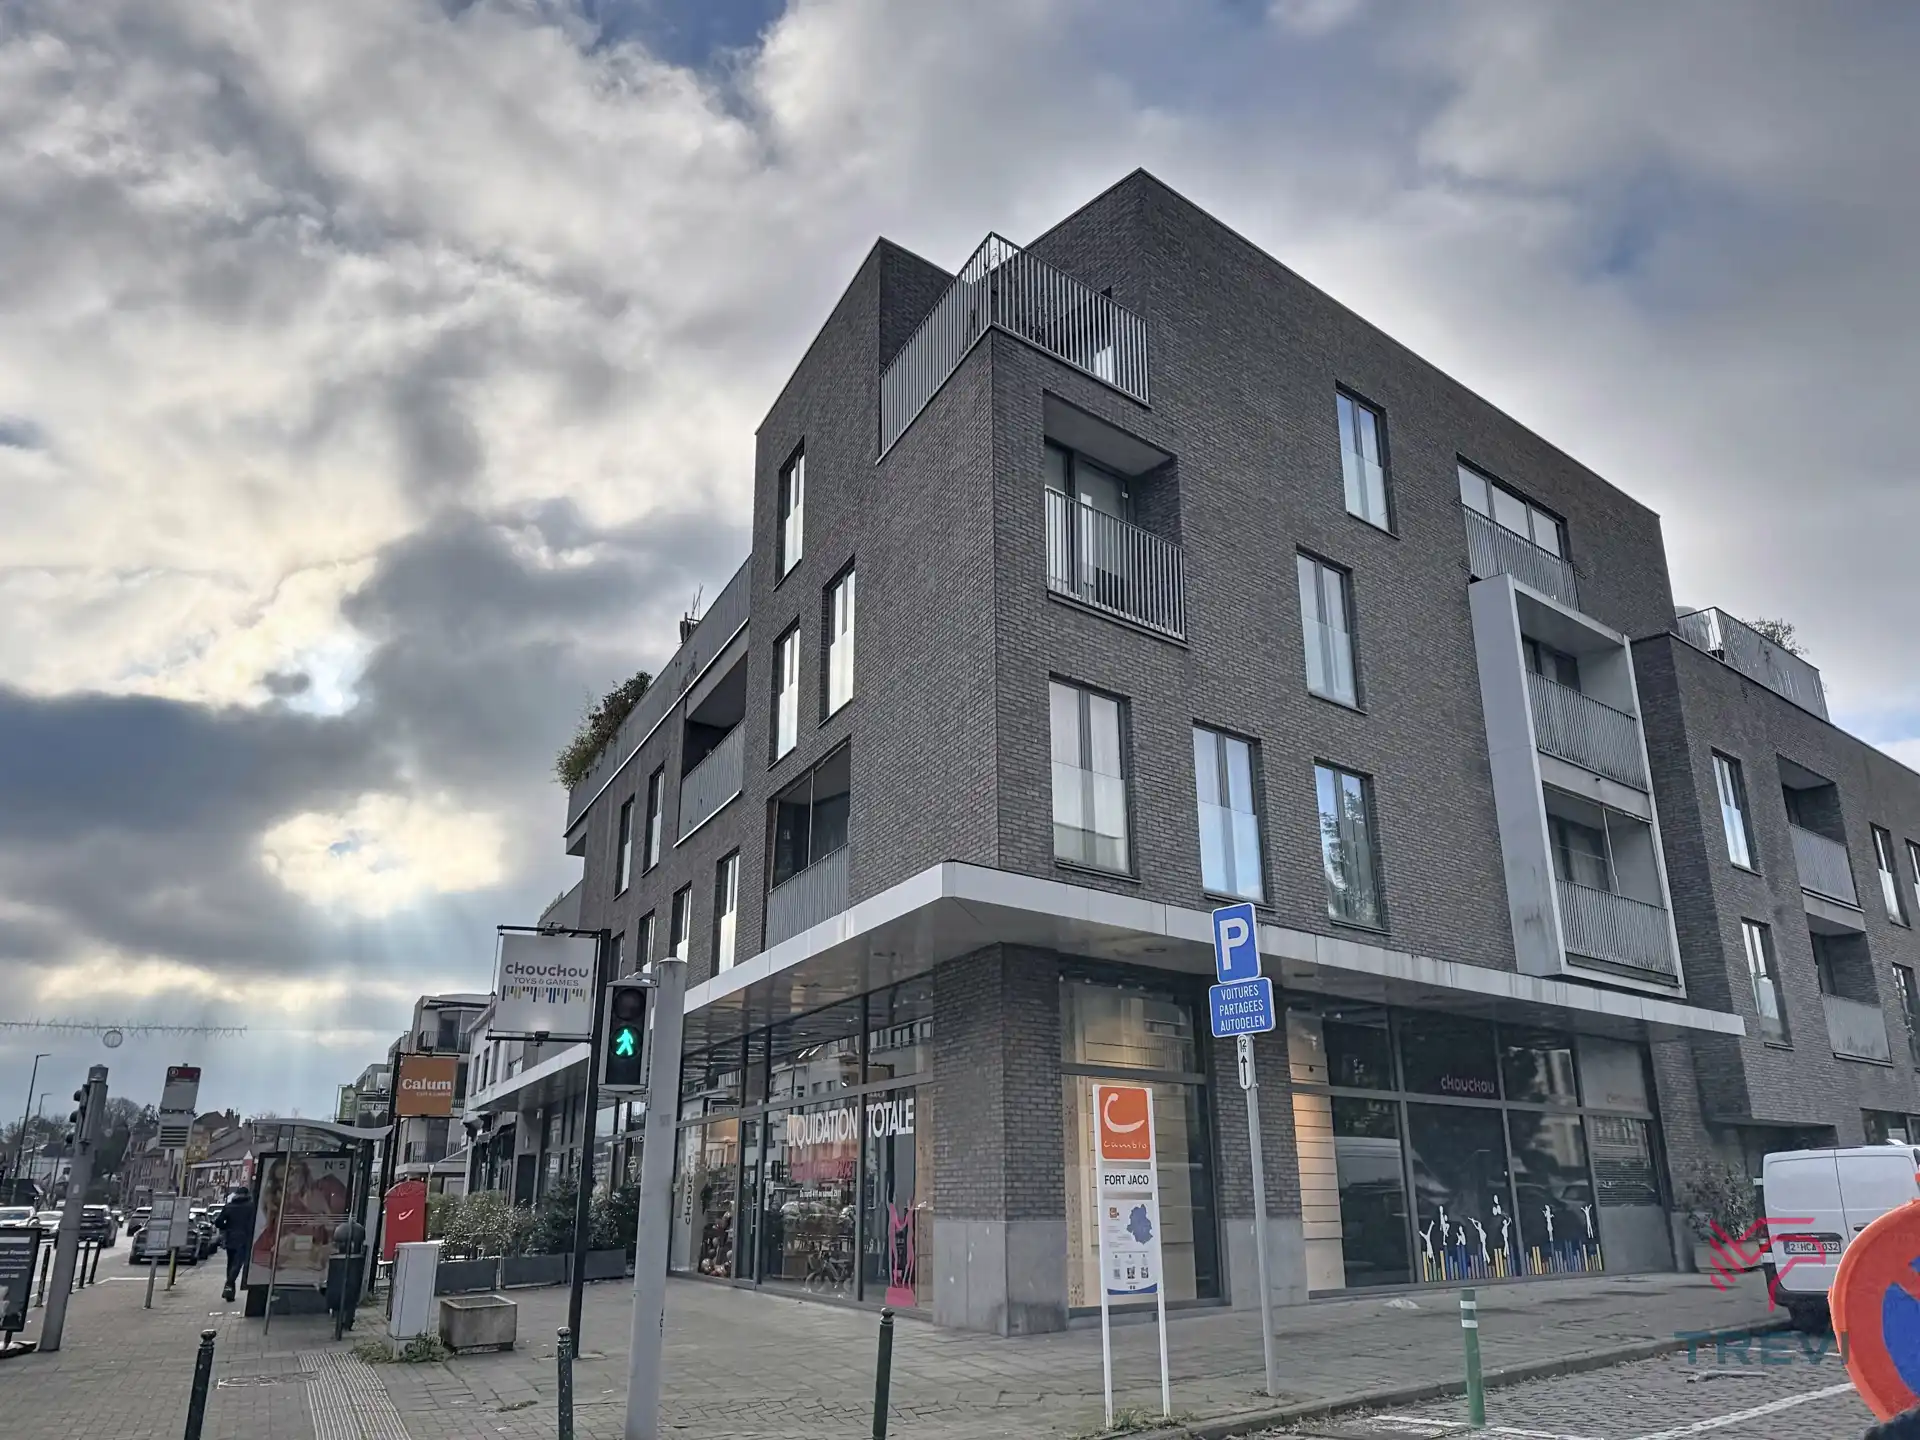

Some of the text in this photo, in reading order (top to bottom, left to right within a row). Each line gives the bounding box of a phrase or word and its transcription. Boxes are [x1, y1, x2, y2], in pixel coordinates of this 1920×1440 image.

[1219, 917, 1249, 971] P
[513, 977, 537, 985] TOYS
[545, 979, 579, 987] GAMES
[1220, 984, 1259, 1001] VOITURES
[1219, 999, 1264, 1017] PARTAGEES
[1220, 1015, 1266, 1032] AUTODELEN
[402, 1077, 452, 1090] Calum
[787, 1098, 914, 1150] LIQUIDATION TOTALE
[1103, 1140, 1148, 1150] cambio
[1104, 1174, 1150, 1186] FORT JACO
